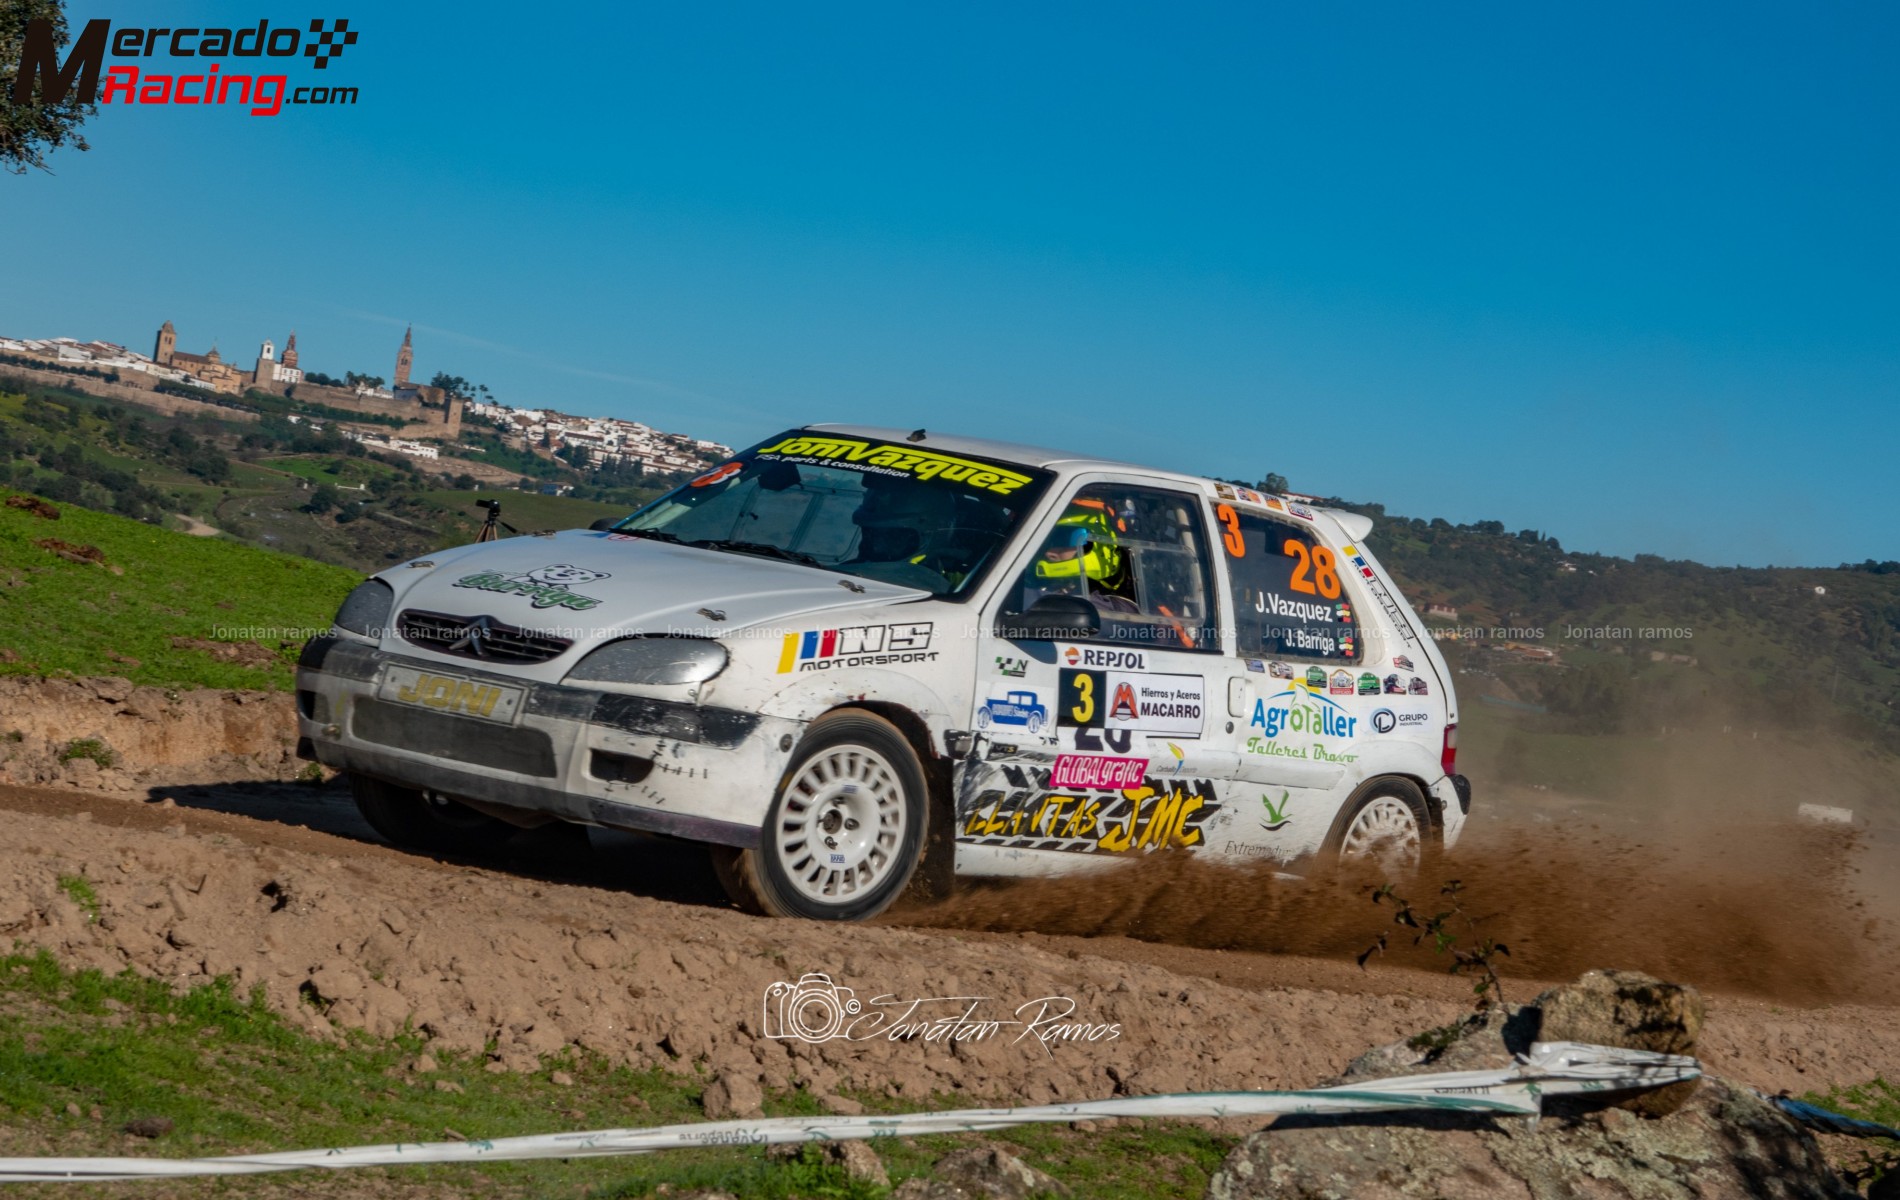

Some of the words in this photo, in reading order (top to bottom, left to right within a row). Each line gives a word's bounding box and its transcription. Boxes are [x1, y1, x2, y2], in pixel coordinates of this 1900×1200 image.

[781, 455, 817, 466] parts
[819, 457, 830, 467] &
[830, 459, 911, 479] consultation
[1216, 503, 1246, 558] 3
[1283, 539, 1342, 600] 28
[838, 622, 934, 656] NS
[1285, 628, 1296, 648] J.
[1297, 629, 1335, 656] Barriga
[799, 651, 940, 672] MOTORSPORT
[1083, 649, 1146, 670] REPSOL
[397, 673, 503, 718] JONI
[1072, 672, 1095, 724] 3
[1141, 687, 1169, 699] Hierros
[1176, 689, 1201, 701] Aceros
[1140, 702, 1201, 720] MACARRO
[1398, 713, 1429, 722] GRUPO
[1246, 736, 1308, 759] Talleres
[1097, 786, 1204, 852] JMC
